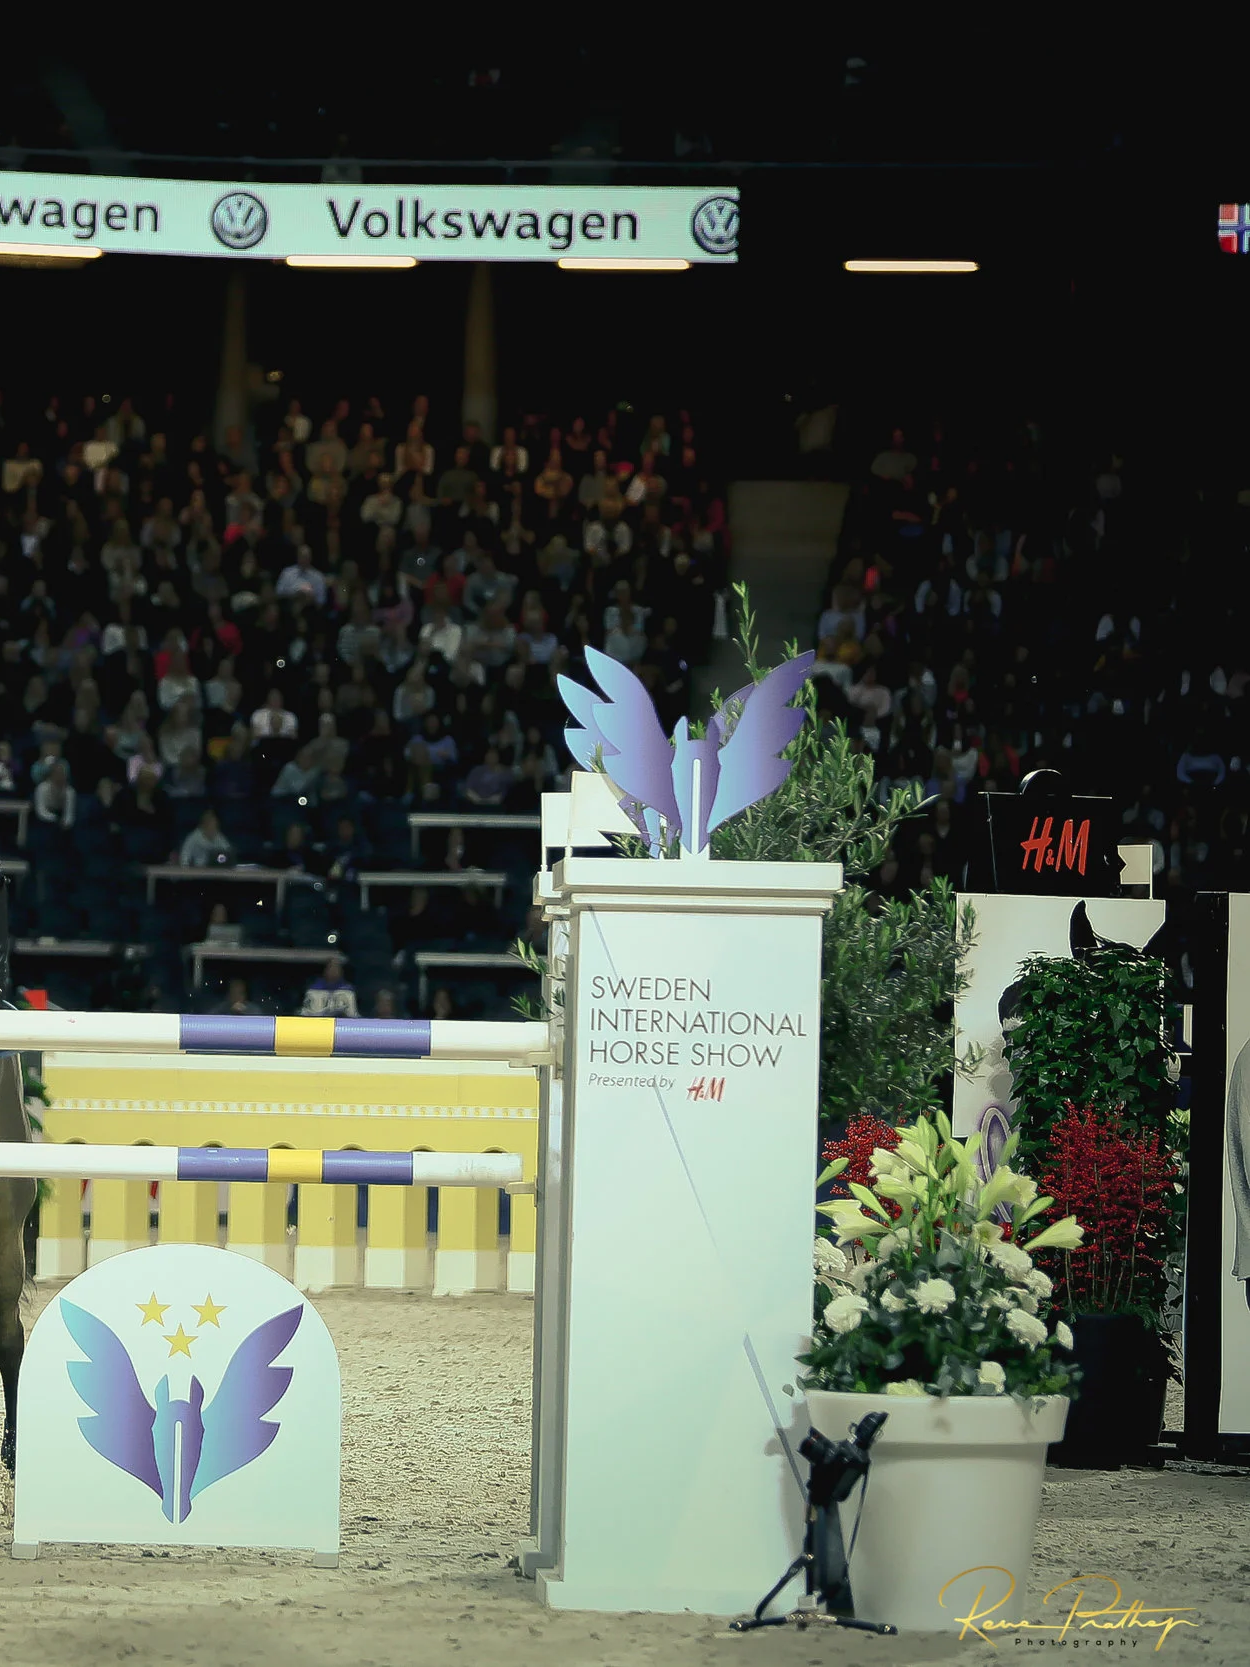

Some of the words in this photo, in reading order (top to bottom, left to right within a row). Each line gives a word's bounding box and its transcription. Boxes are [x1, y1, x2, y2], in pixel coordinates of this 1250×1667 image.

[326, 198, 638, 250] Volkswagen
[1020, 816, 1090, 876] H&M
[590, 976, 711, 1002] SWEDEN
[590, 1008, 808, 1037] INTERNATIONAL
[589, 1040, 679, 1066] HORSE
[690, 1042, 783, 1068] SHOW
[588, 1072, 657, 1089] Presented
[658, 1073, 677, 1091] by
[686, 1076, 726, 1102] H&M
